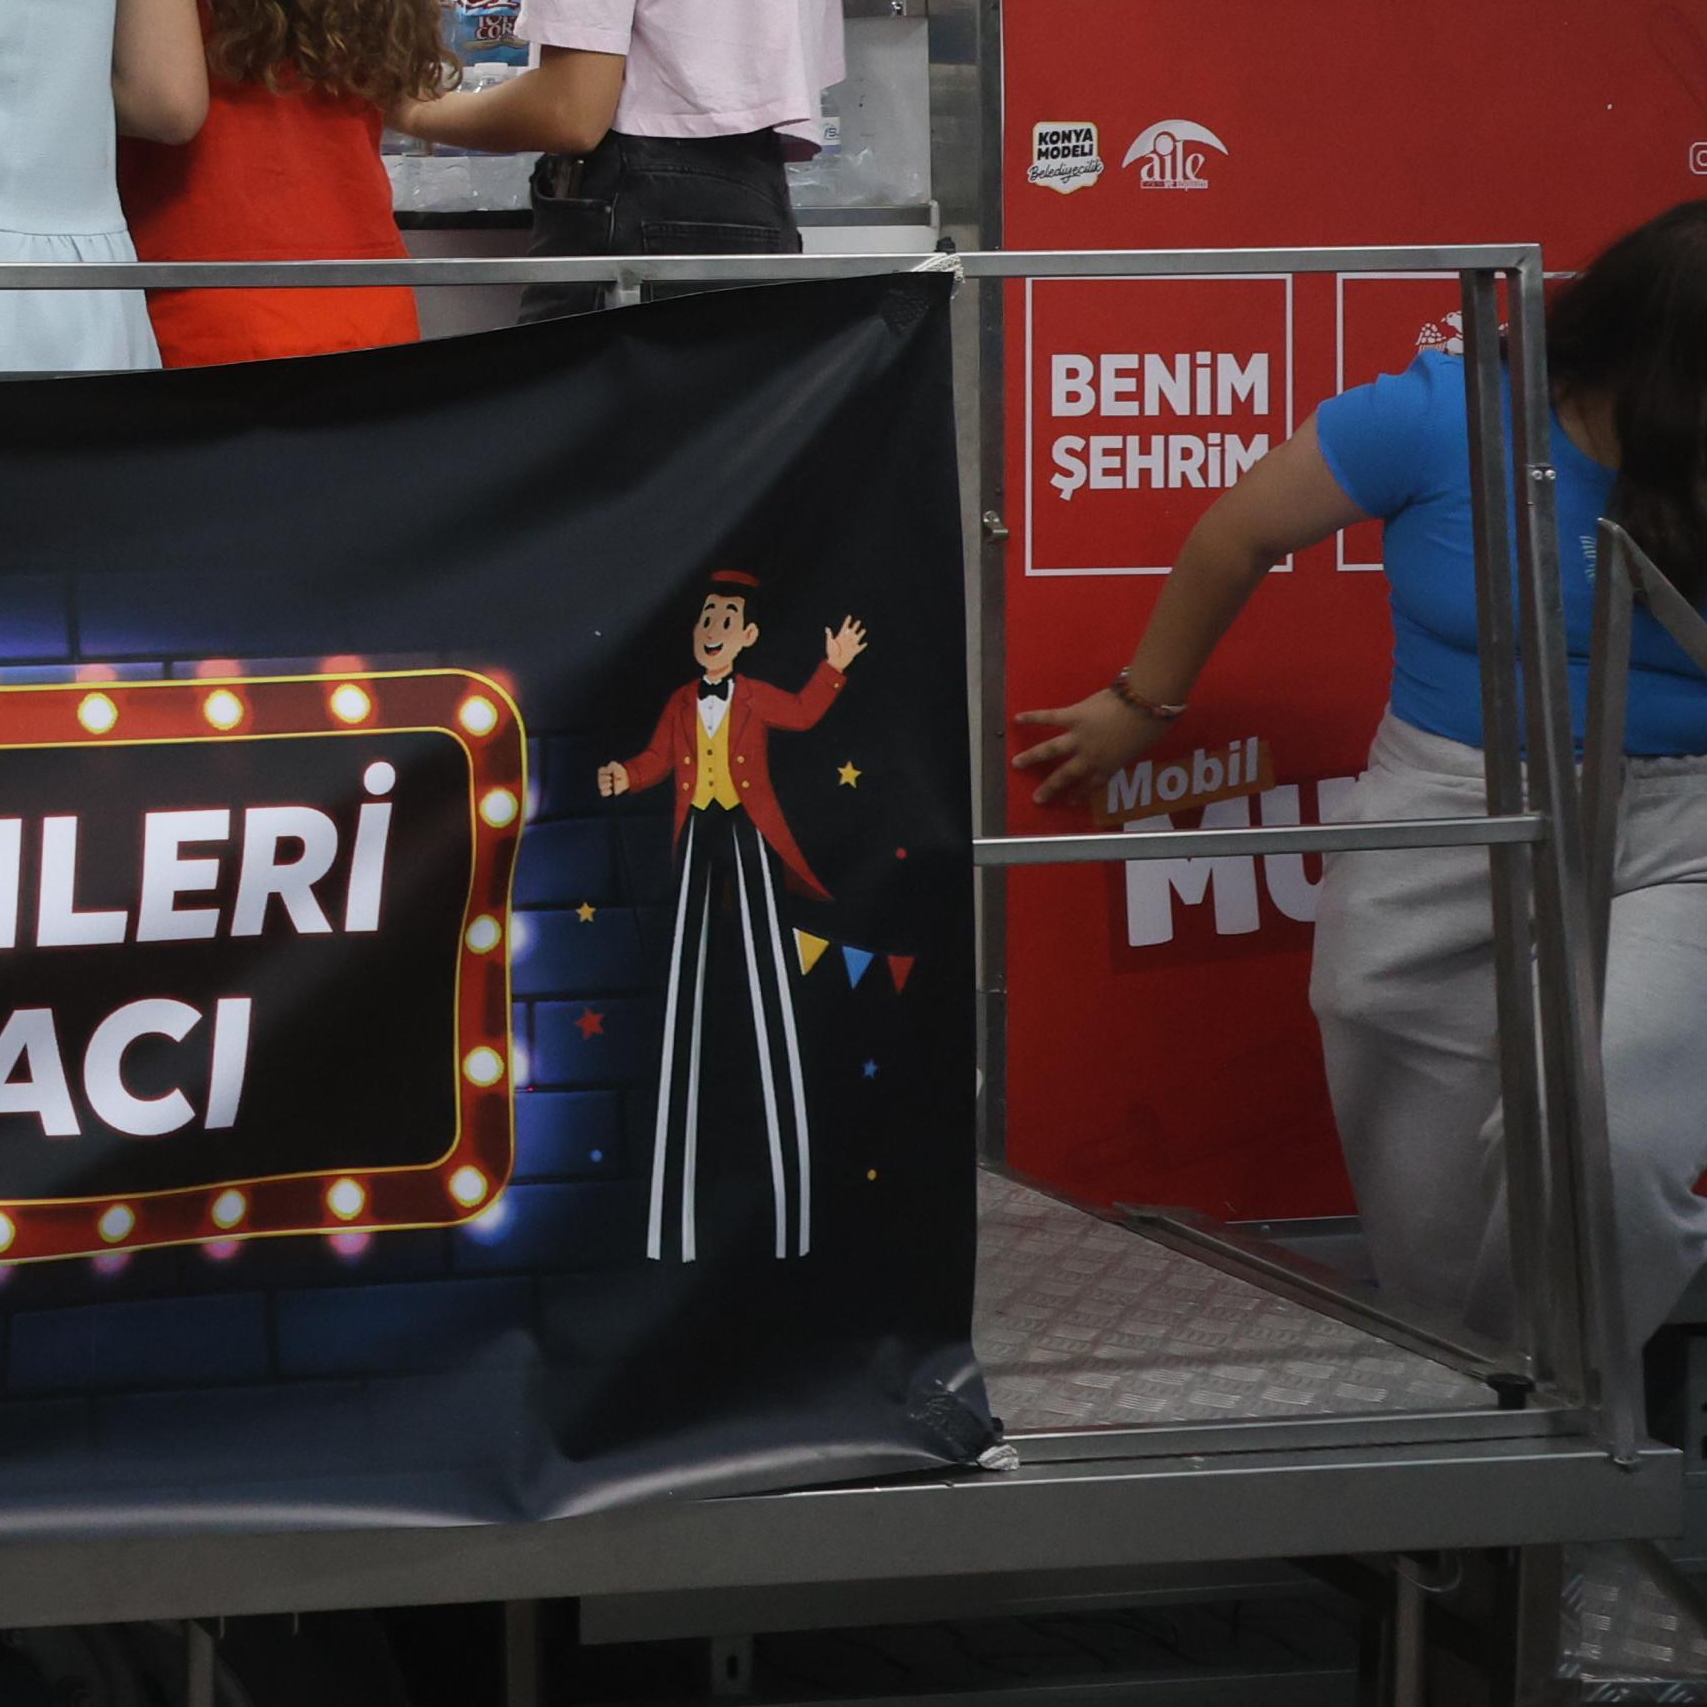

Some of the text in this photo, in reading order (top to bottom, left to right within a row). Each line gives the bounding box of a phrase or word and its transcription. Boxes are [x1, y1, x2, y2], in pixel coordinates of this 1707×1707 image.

[1038, 127, 1094, 146] KONYA
[1140, 134, 1206, 182] aile
[1106, 735, 1260, 815] Mobil
